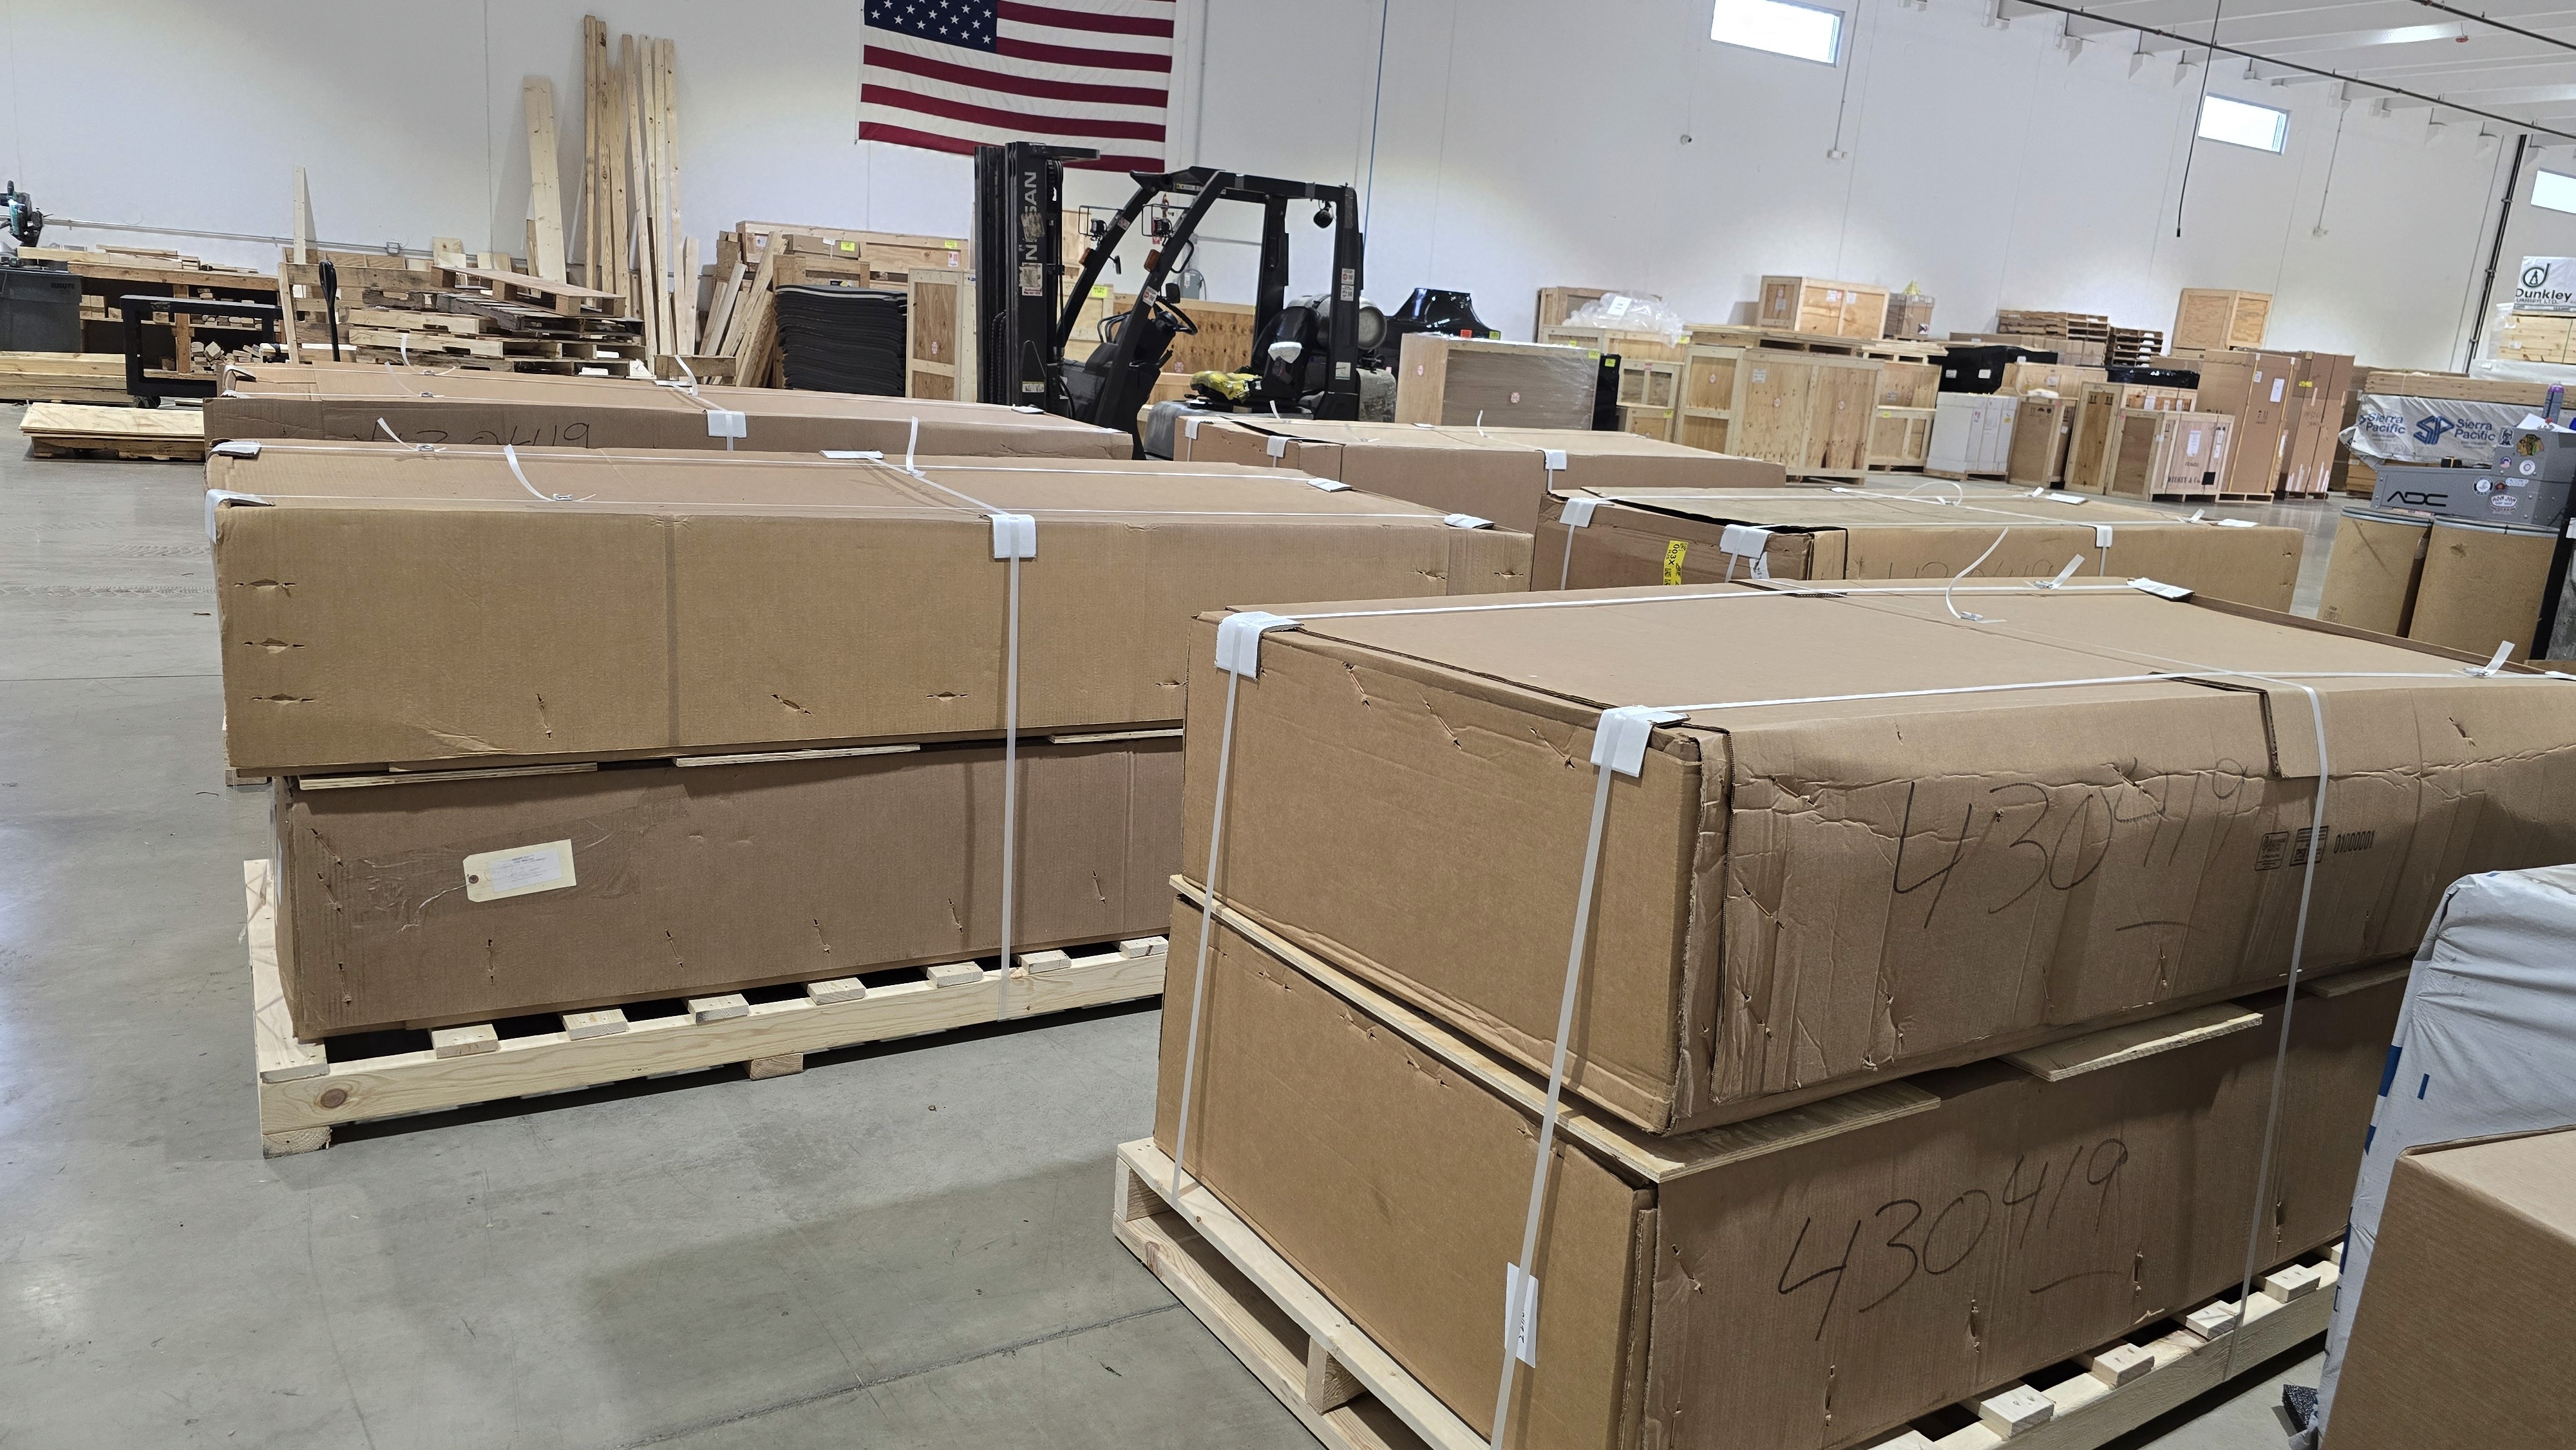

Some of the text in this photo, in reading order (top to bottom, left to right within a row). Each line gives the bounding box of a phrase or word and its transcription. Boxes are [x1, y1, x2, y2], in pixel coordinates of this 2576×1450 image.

[1024, 171, 1038, 260] NISAN
[2515, 288, 2573, 303] Dunkley
[2368, 413, 2403, 424] Sierra
[2456, 419, 2492, 431] Sierra
[2366, 422, 2406, 434] Pacific
[2454, 428, 2496, 441] Pacific
[2387, 491, 2448, 507] ADC
[1668, 543, 1680, 565] 003X
[1893, 757, 2248, 928] 430419
[1778, 1138, 2128, 1341] 430419
